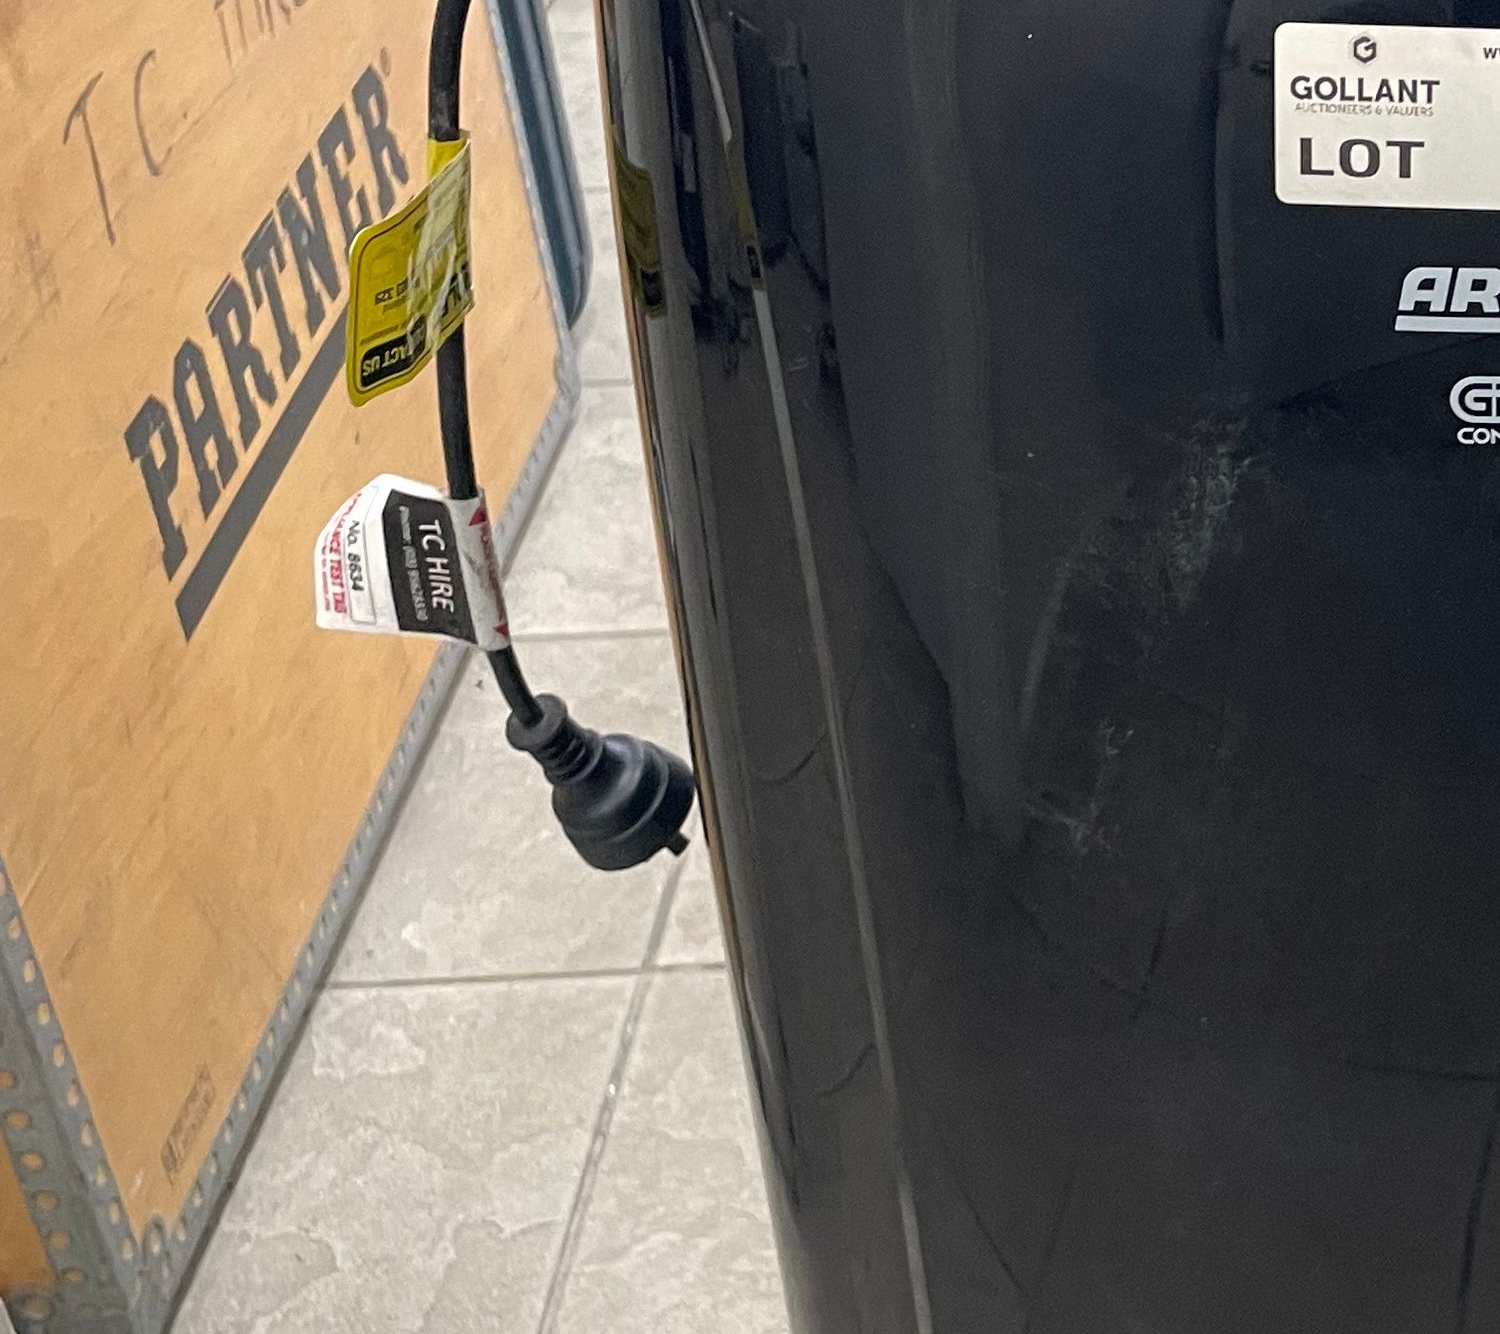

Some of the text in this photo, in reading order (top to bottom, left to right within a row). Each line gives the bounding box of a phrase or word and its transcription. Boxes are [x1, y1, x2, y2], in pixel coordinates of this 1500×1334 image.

[1290, 75, 1441, 104] GOLLANT
[1295, 102, 1372, 116] AUCTIONEERS
[1300, 137, 1425, 179] LOT
[123, 62, 408, 582] PARTNER
[418, 519, 446, 551] TC
[425, 557, 455, 613] HIRE
